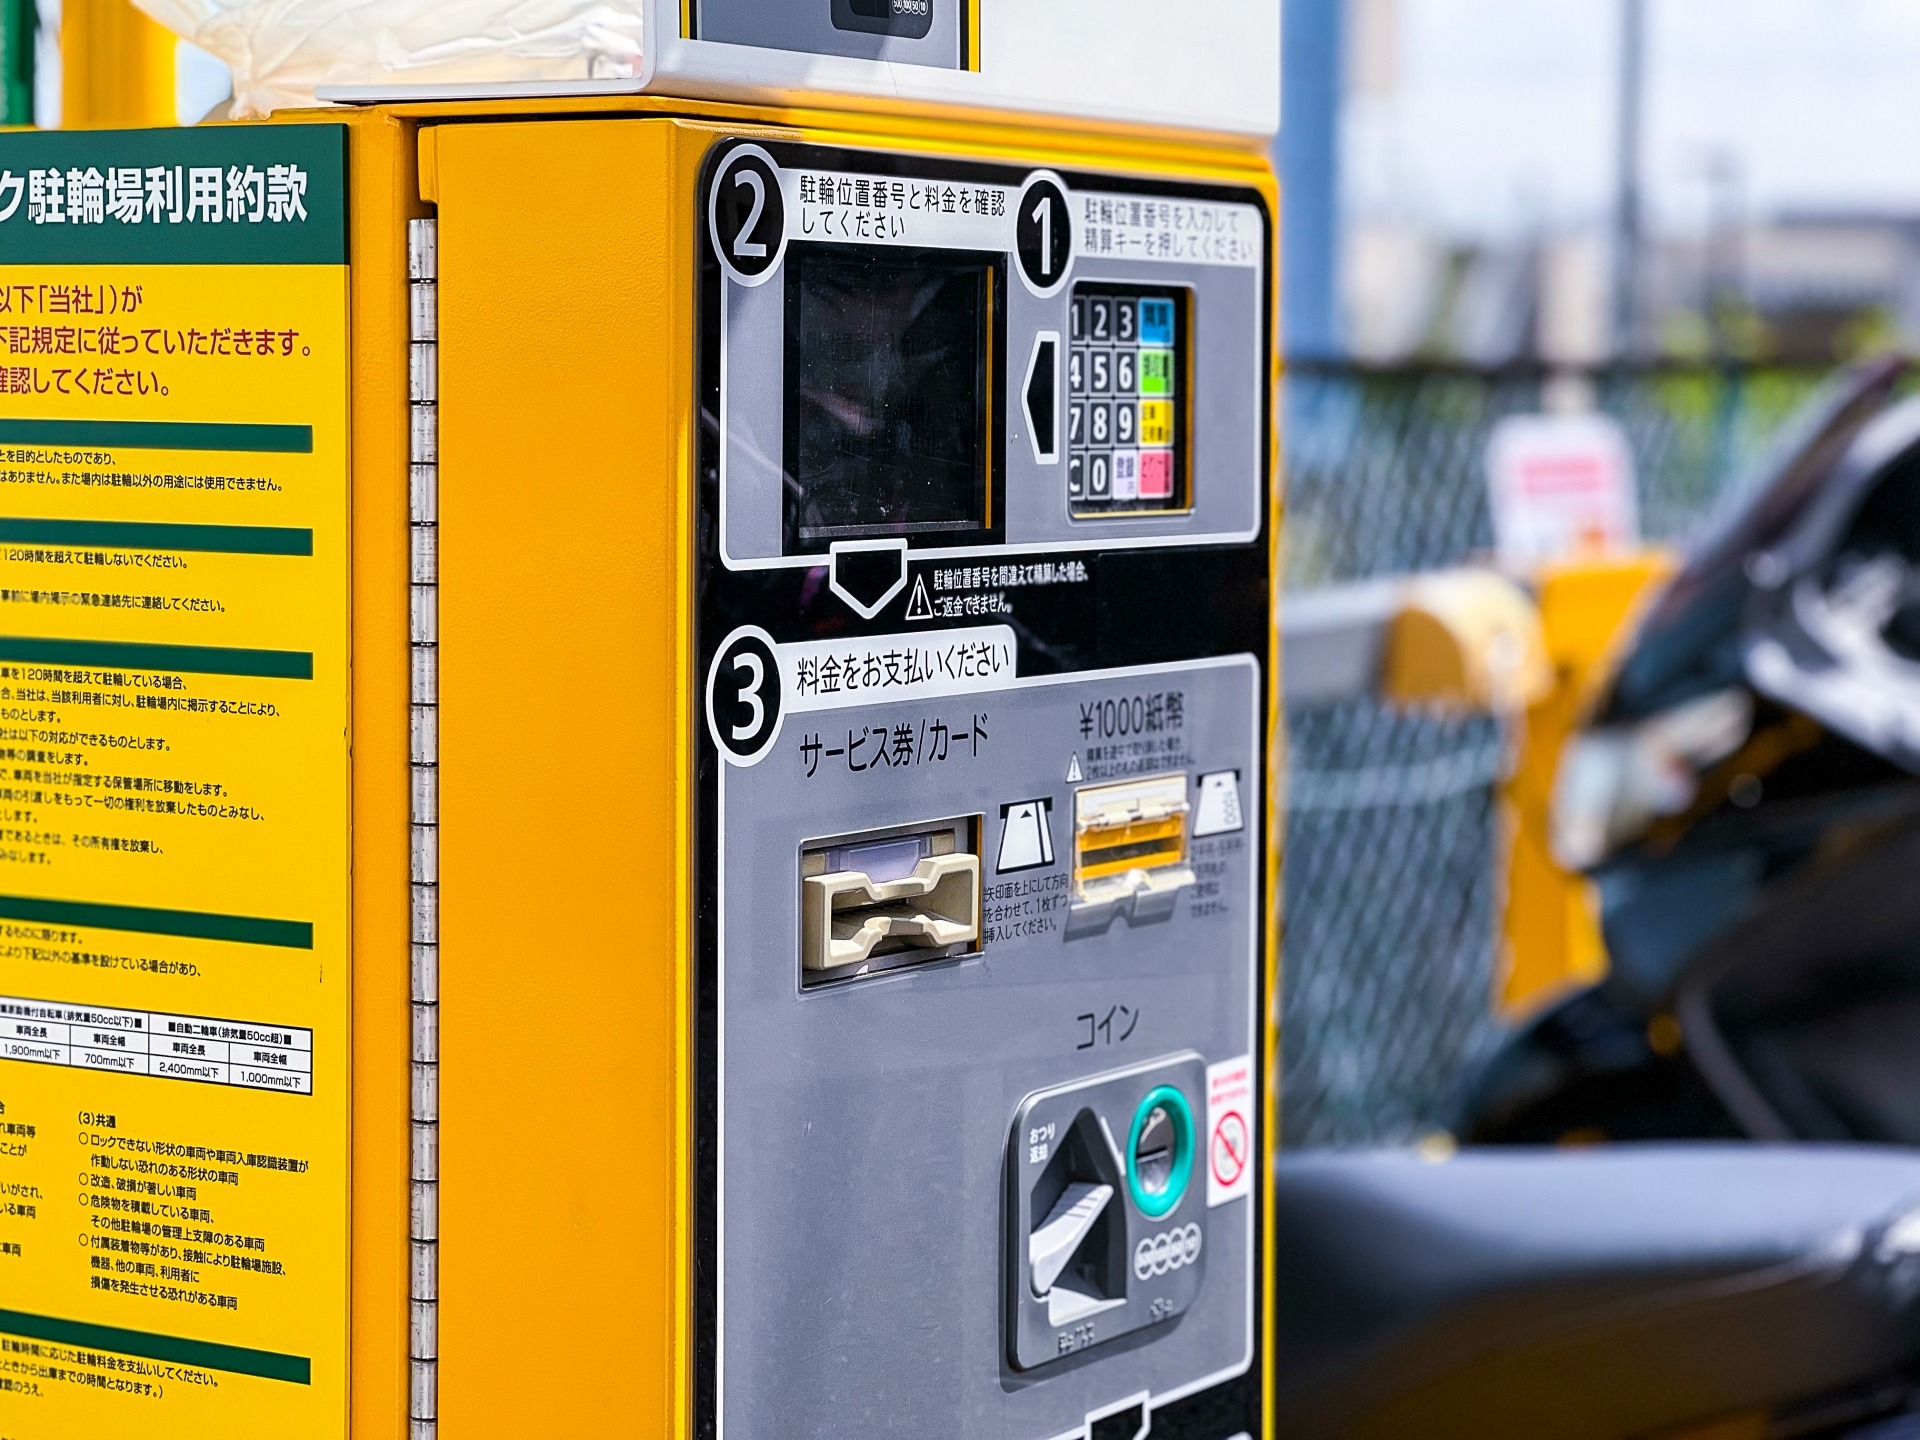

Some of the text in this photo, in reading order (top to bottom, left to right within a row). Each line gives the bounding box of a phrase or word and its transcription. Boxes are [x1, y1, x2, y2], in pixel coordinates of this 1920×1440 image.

[0, 164, 308, 225] ク駐輪場利用約款
[800, 174, 1006, 217] 駐輪位置番号と料金を確認
[733, 168, 767, 258] 2
[801, 208, 906, 239] してください
[1084, 197, 1240, 234] 駐輪位置番号を入力して
[1031, 197, 1051, 275] 1
[1084, 226, 1254, 262] 精算キーを押してください
[1071, 304, 1079, 336] 1
[1094, 304, 1107, 337] 2
[1119, 305, 1132, 338] 3
[1094, 355, 1107, 390] 5
[1118, 355, 1132, 390] 6
[1070, 407, 1081, 440] 7
[1093, 406, 1107, 441] 8
[1118, 406, 1133, 440] 9
[933, 591, 1014, 617] ご返金できません。
[797, 640, 1010, 697] 料金をお支払いください
[731, 652, 765, 741] 3
[1, 708, 62, 724] ものとします。
[800, 713, 989, 778] サービス券/カード
[0, 787, 265, 821] 両の引渡しをもって一切の権利を放棄したものとみなし、
[0, 808, 38, 824] します。
[0, 828, 164, 854] であるときは、その所有権を放棄し、
[984, 873, 1069, 903] 矢印面を上にして方向
[0, 924, 83, 945] るものに限ります。
[983, 916, 1057, 945] 挿入してください。
[16, 1025, 48, 1039] 車両全長
[93, 1033, 126, 1047] 車両全幅
[1076, 1004, 1139, 1050] コイン
[84, 1053, 135, 1069] 700mm以下
[172, 1042, 206, 1056] 車両全長
[253, 1051, 288, 1066] 車両全幅
[159, 1062, 219, 1079] 2,400mm以下
[240, 1071, 301, 1089] 1,000mm以下
[78, 1110, 117, 1128] (3)共通
[90, 1153, 239, 1186] 作動しない恐れのある形状の車両
[90, 1214, 265, 1252] その他駐輪場の管理上支障のある車両
[90, 1255, 200, 1283] 機器、他の車両、利用者に
[90, 1275, 238, 1311] 損傷を発生させる恐れがある車両
[0, 1377, 44, 1398] 認のうえ、
